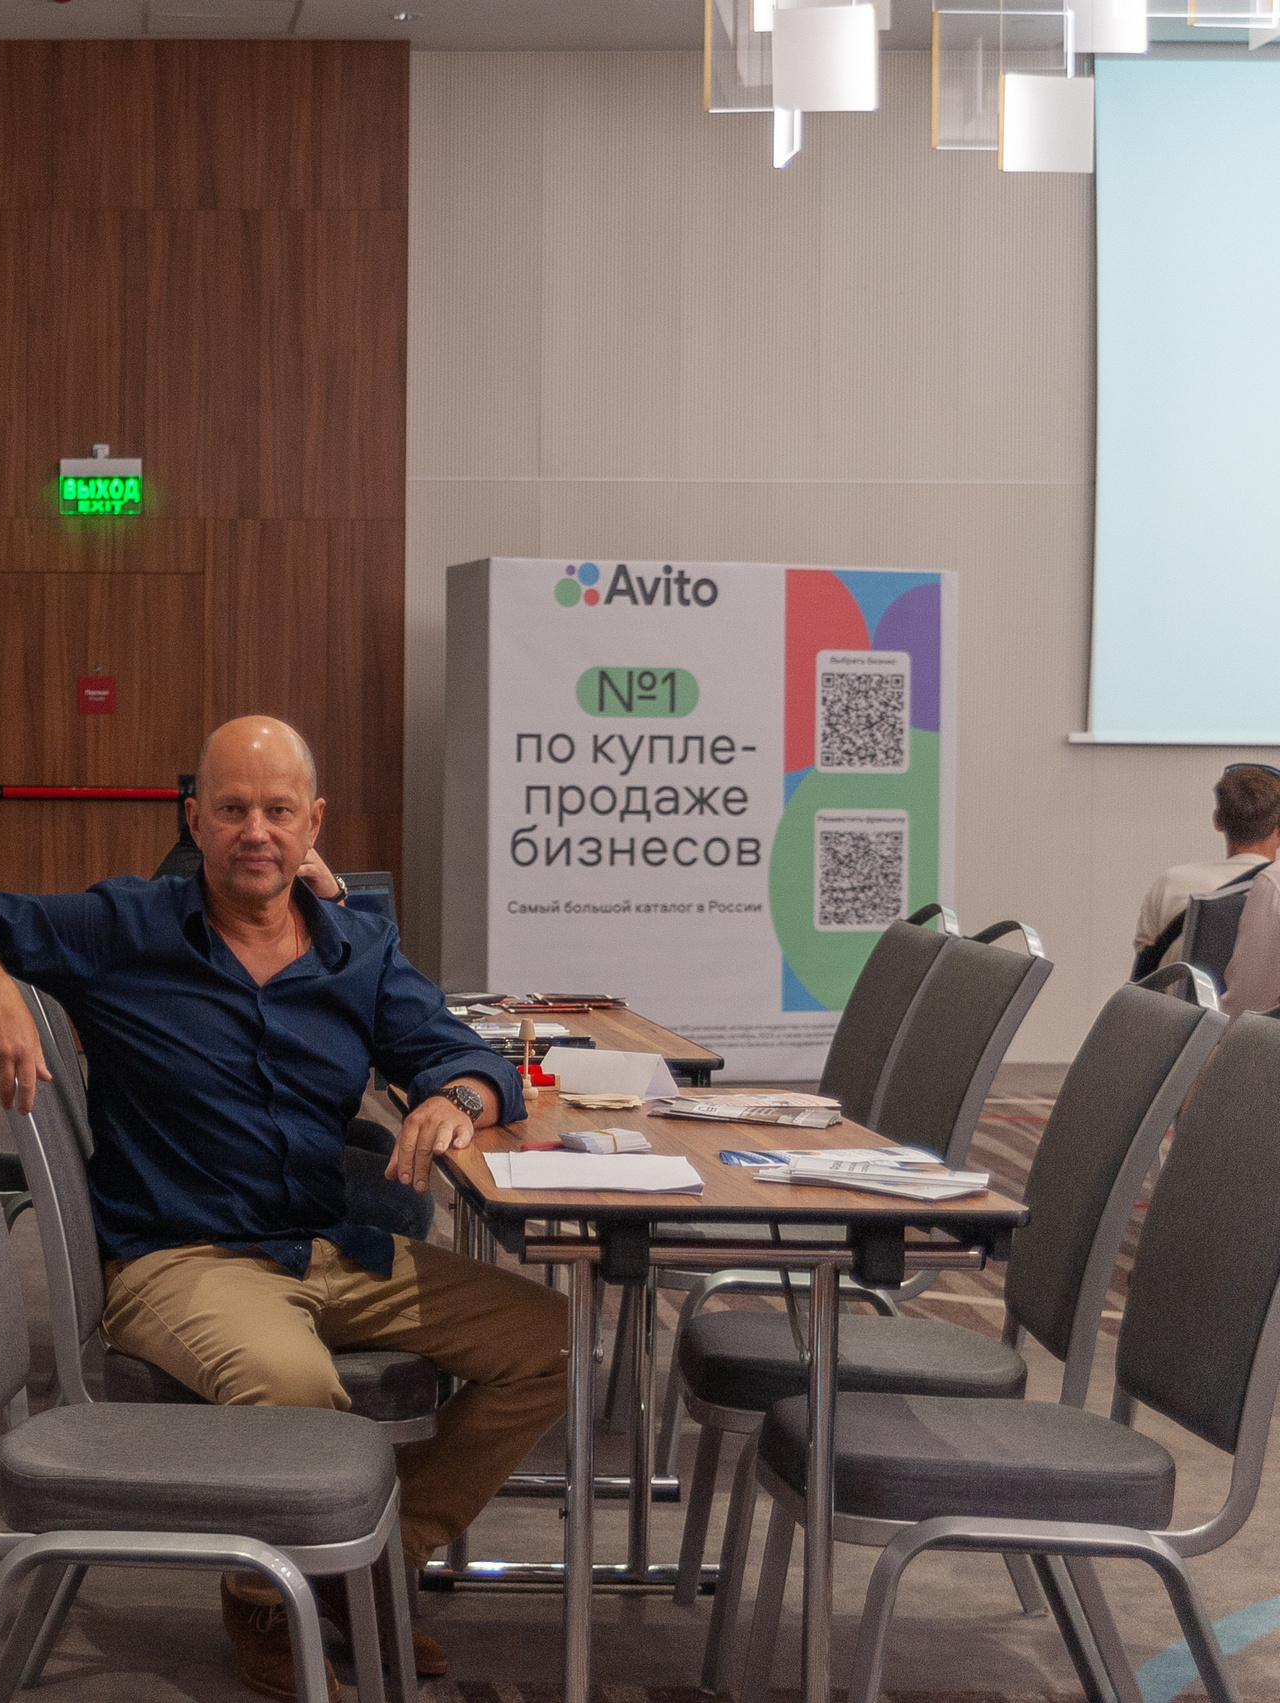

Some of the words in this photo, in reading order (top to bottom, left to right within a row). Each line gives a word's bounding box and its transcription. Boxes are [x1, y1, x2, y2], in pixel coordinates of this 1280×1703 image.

[62, 478, 140, 503] ВЫХОД
[78, 500, 125, 514] EXIT
[604, 563, 720, 609] Avito
[597, 670, 677, 715] №1
[516, 733, 577, 766] по
[593, 734, 758, 777] купле-
[525, 785, 750, 828] продаже
[510, 825, 763, 869] бизнесов
[507, 900, 561, 915] Самый
[563, 900, 631, 915] большой
[634, 903, 693, 915] каталог
[697, 904, 705, 914] в
[708, 900, 763, 915] России
